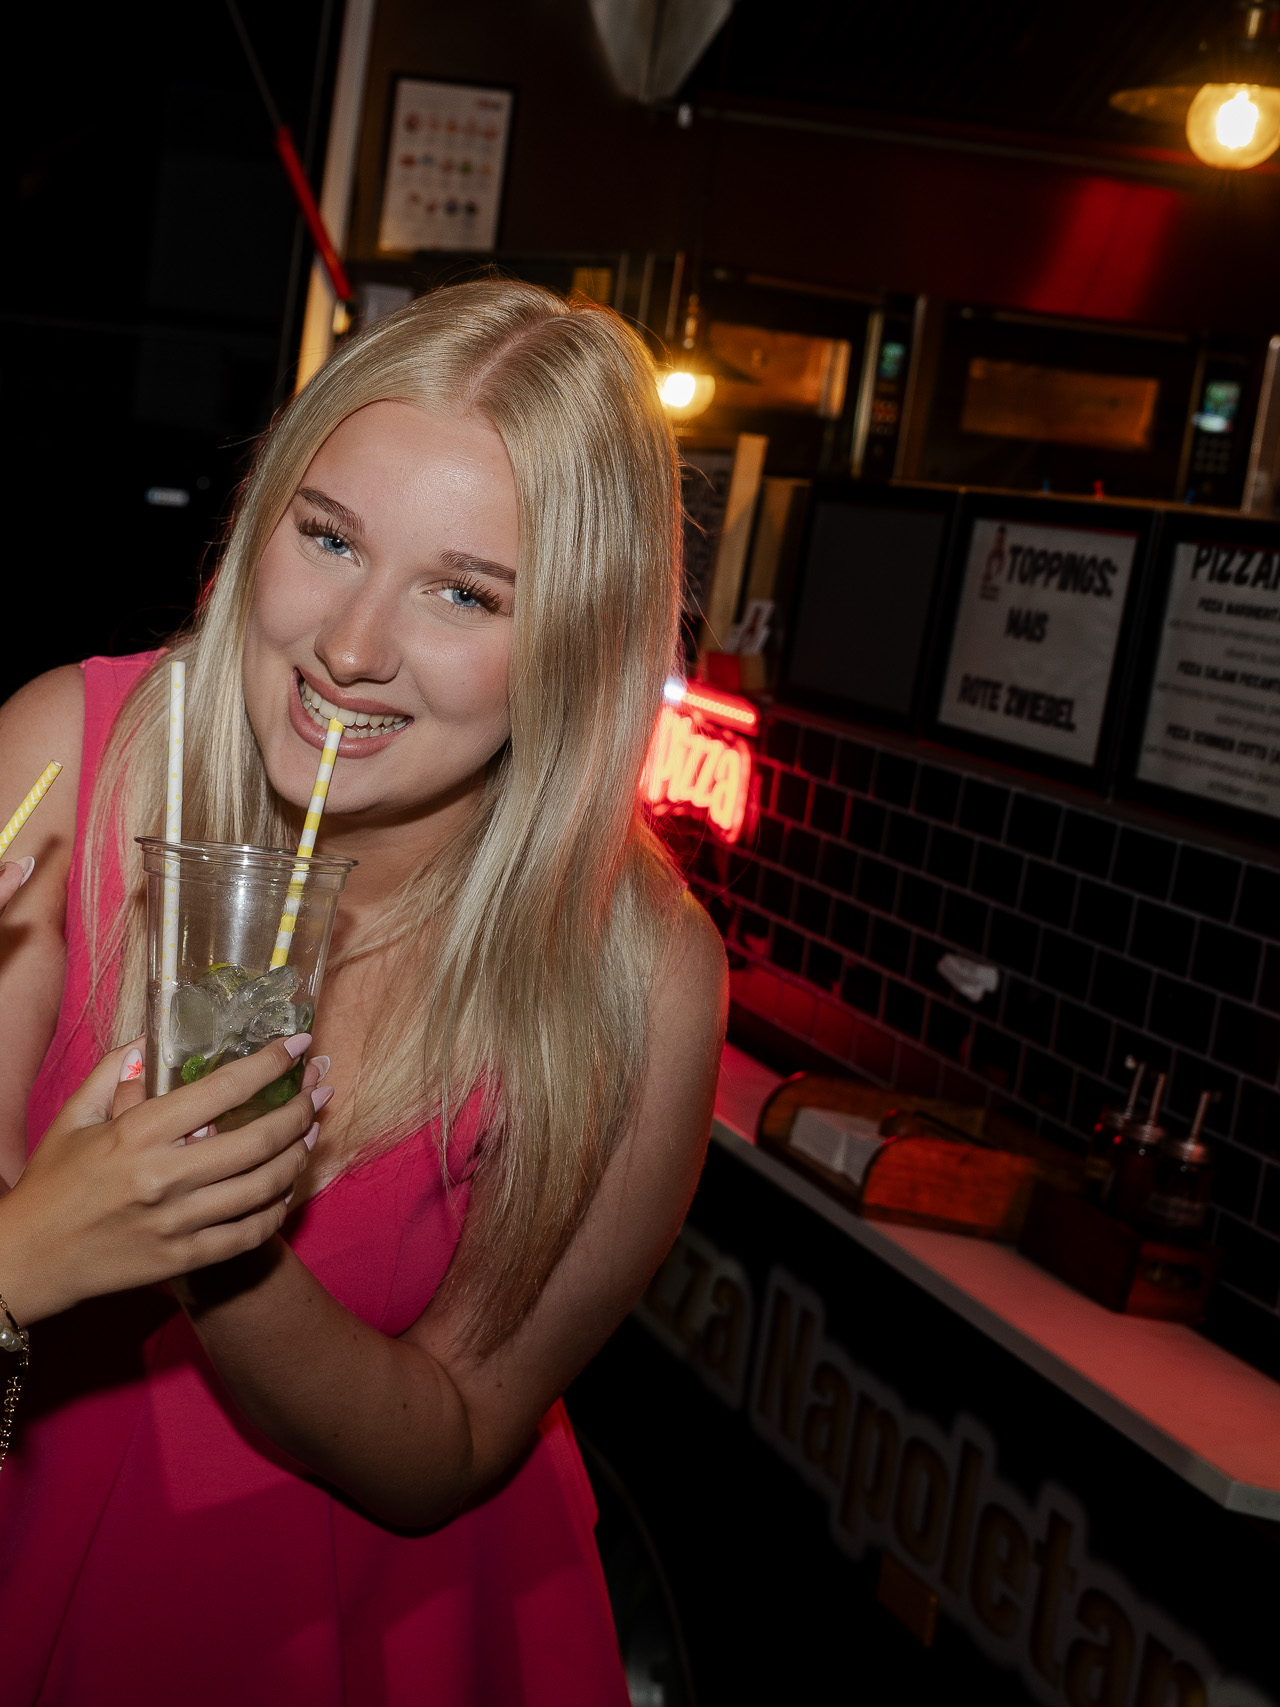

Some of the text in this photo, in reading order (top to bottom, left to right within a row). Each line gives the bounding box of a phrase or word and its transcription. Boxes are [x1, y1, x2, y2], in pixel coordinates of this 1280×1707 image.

[1007, 545, 1118, 598] TOPPINGS:
[1191, 544, 1280, 590] PIZZA
[1004, 607, 1049, 643] MAIS
[957, 673, 1077, 733] ROTE ZWIEBEL
[757, 1288, 1210, 1707] Napoletan
